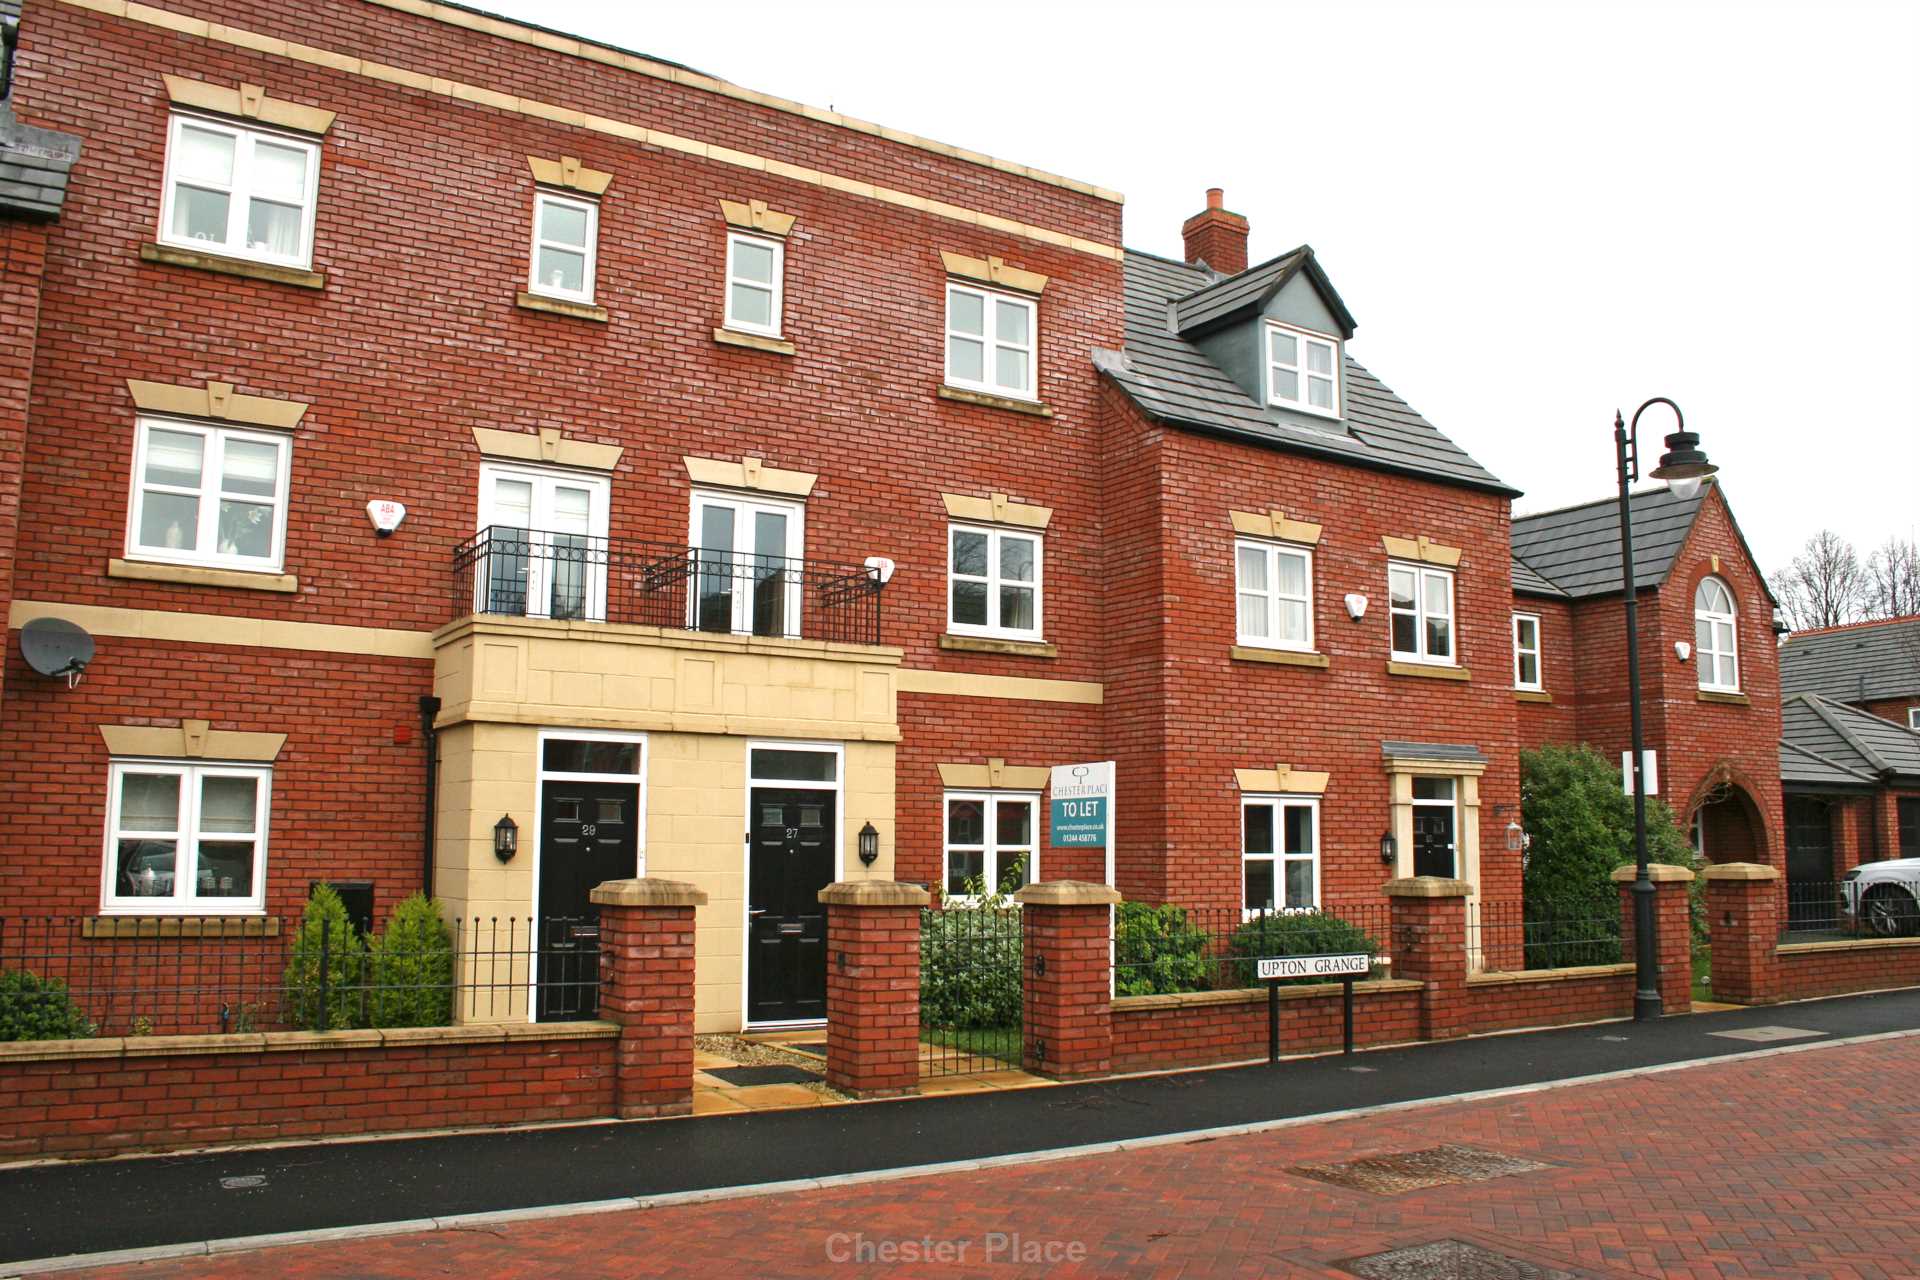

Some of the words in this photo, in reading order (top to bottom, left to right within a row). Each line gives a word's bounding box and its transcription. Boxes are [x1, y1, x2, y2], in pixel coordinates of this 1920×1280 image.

[1062, 801, 1077, 817] TO
[1080, 801, 1099, 816] LET
[582, 824, 596, 836] 29
[786, 828, 799, 839] 27
[1262, 960, 1307, 976] UPTON
[1314, 957, 1365, 973] GRANGE
